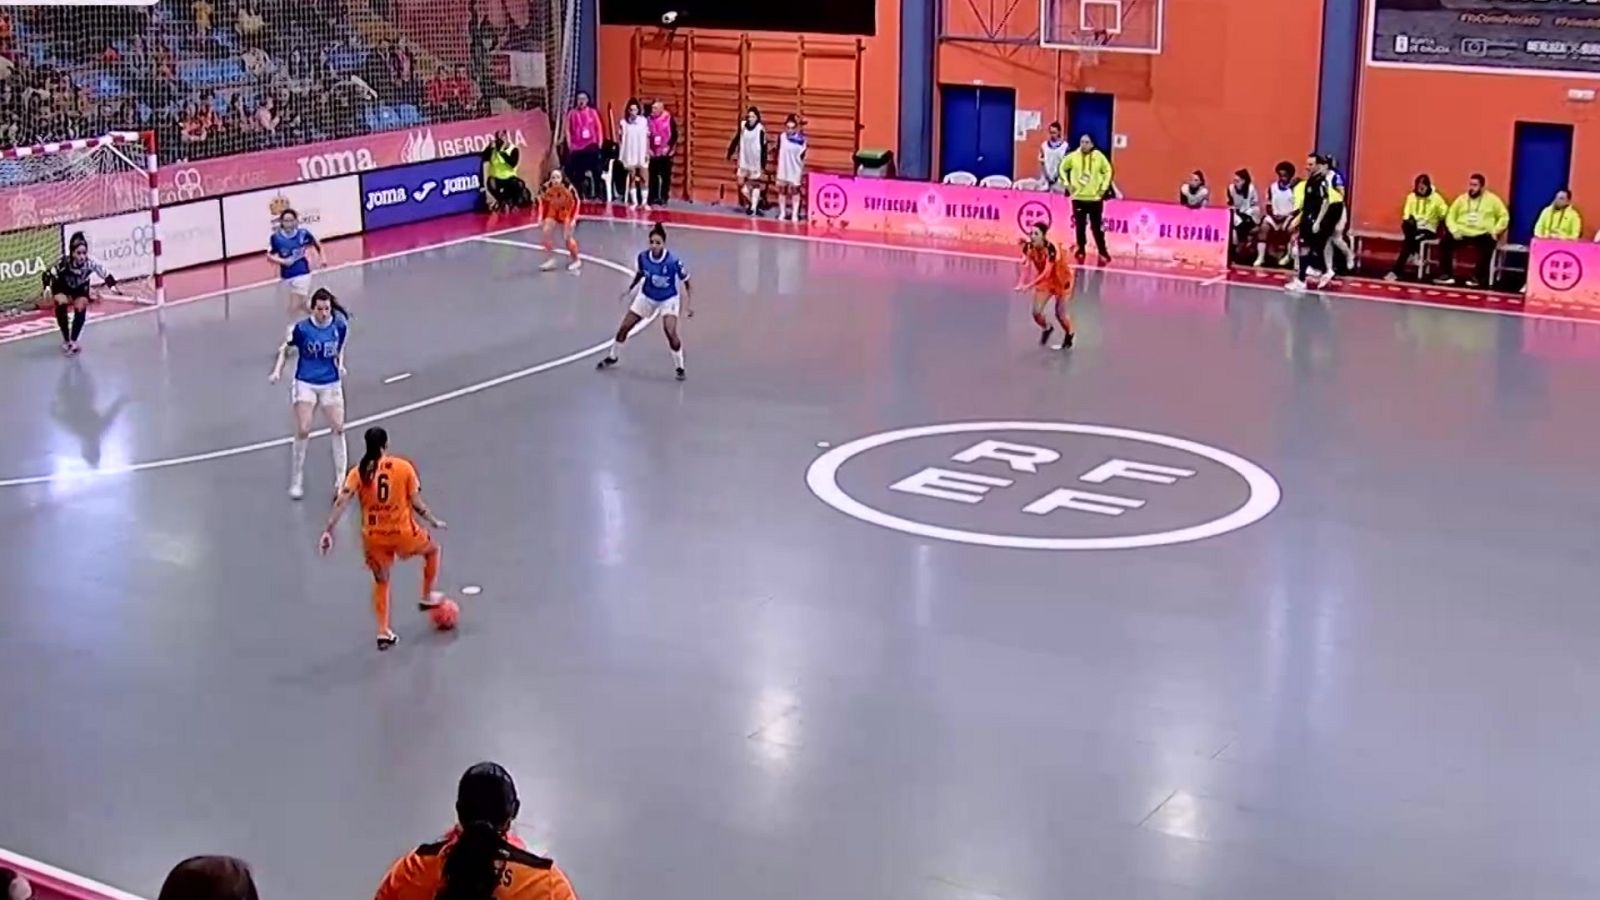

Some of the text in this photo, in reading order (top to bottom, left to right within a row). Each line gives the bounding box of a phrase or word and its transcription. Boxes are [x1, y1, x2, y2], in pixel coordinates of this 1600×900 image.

[438, 129, 527, 159] IBERDRLA
[864, 196, 1000, 221] SUPERCOPA DE ESPAÑA
[1159, 223, 1171, 238] DE
[1176, 223, 1219, 242] ESPAÑA
[0, 256, 46, 281] ROLA
[377, 473, 389, 503] 6
